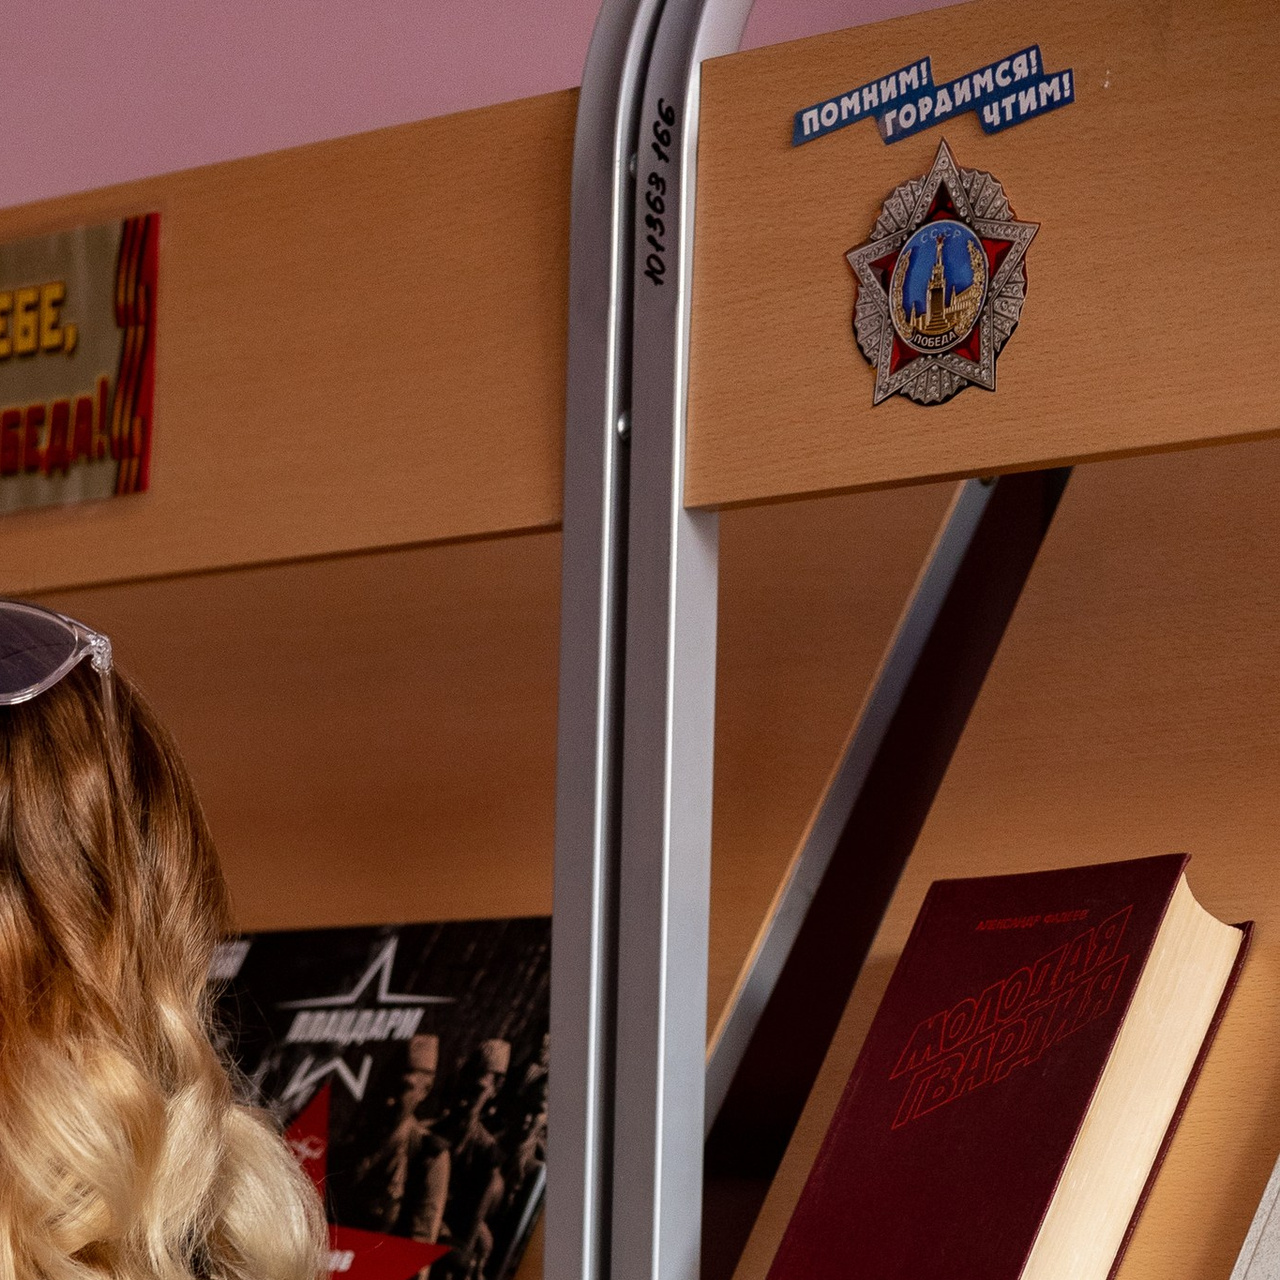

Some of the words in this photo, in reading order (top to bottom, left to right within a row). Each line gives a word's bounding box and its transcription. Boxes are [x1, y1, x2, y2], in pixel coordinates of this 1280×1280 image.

[802, 61, 928, 136] ПОМНИМ!
[884, 49, 1038, 137] ГОРДИМСЯ!
[982, 72, 1071, 127] ЧТИМ!
[913, 331, 957, 347] ПОБЕДА
[889, 903, 1134, 1080] МОЛОДАЯ
[891, 954, 1130, 1130] ГВАРДИЯ
